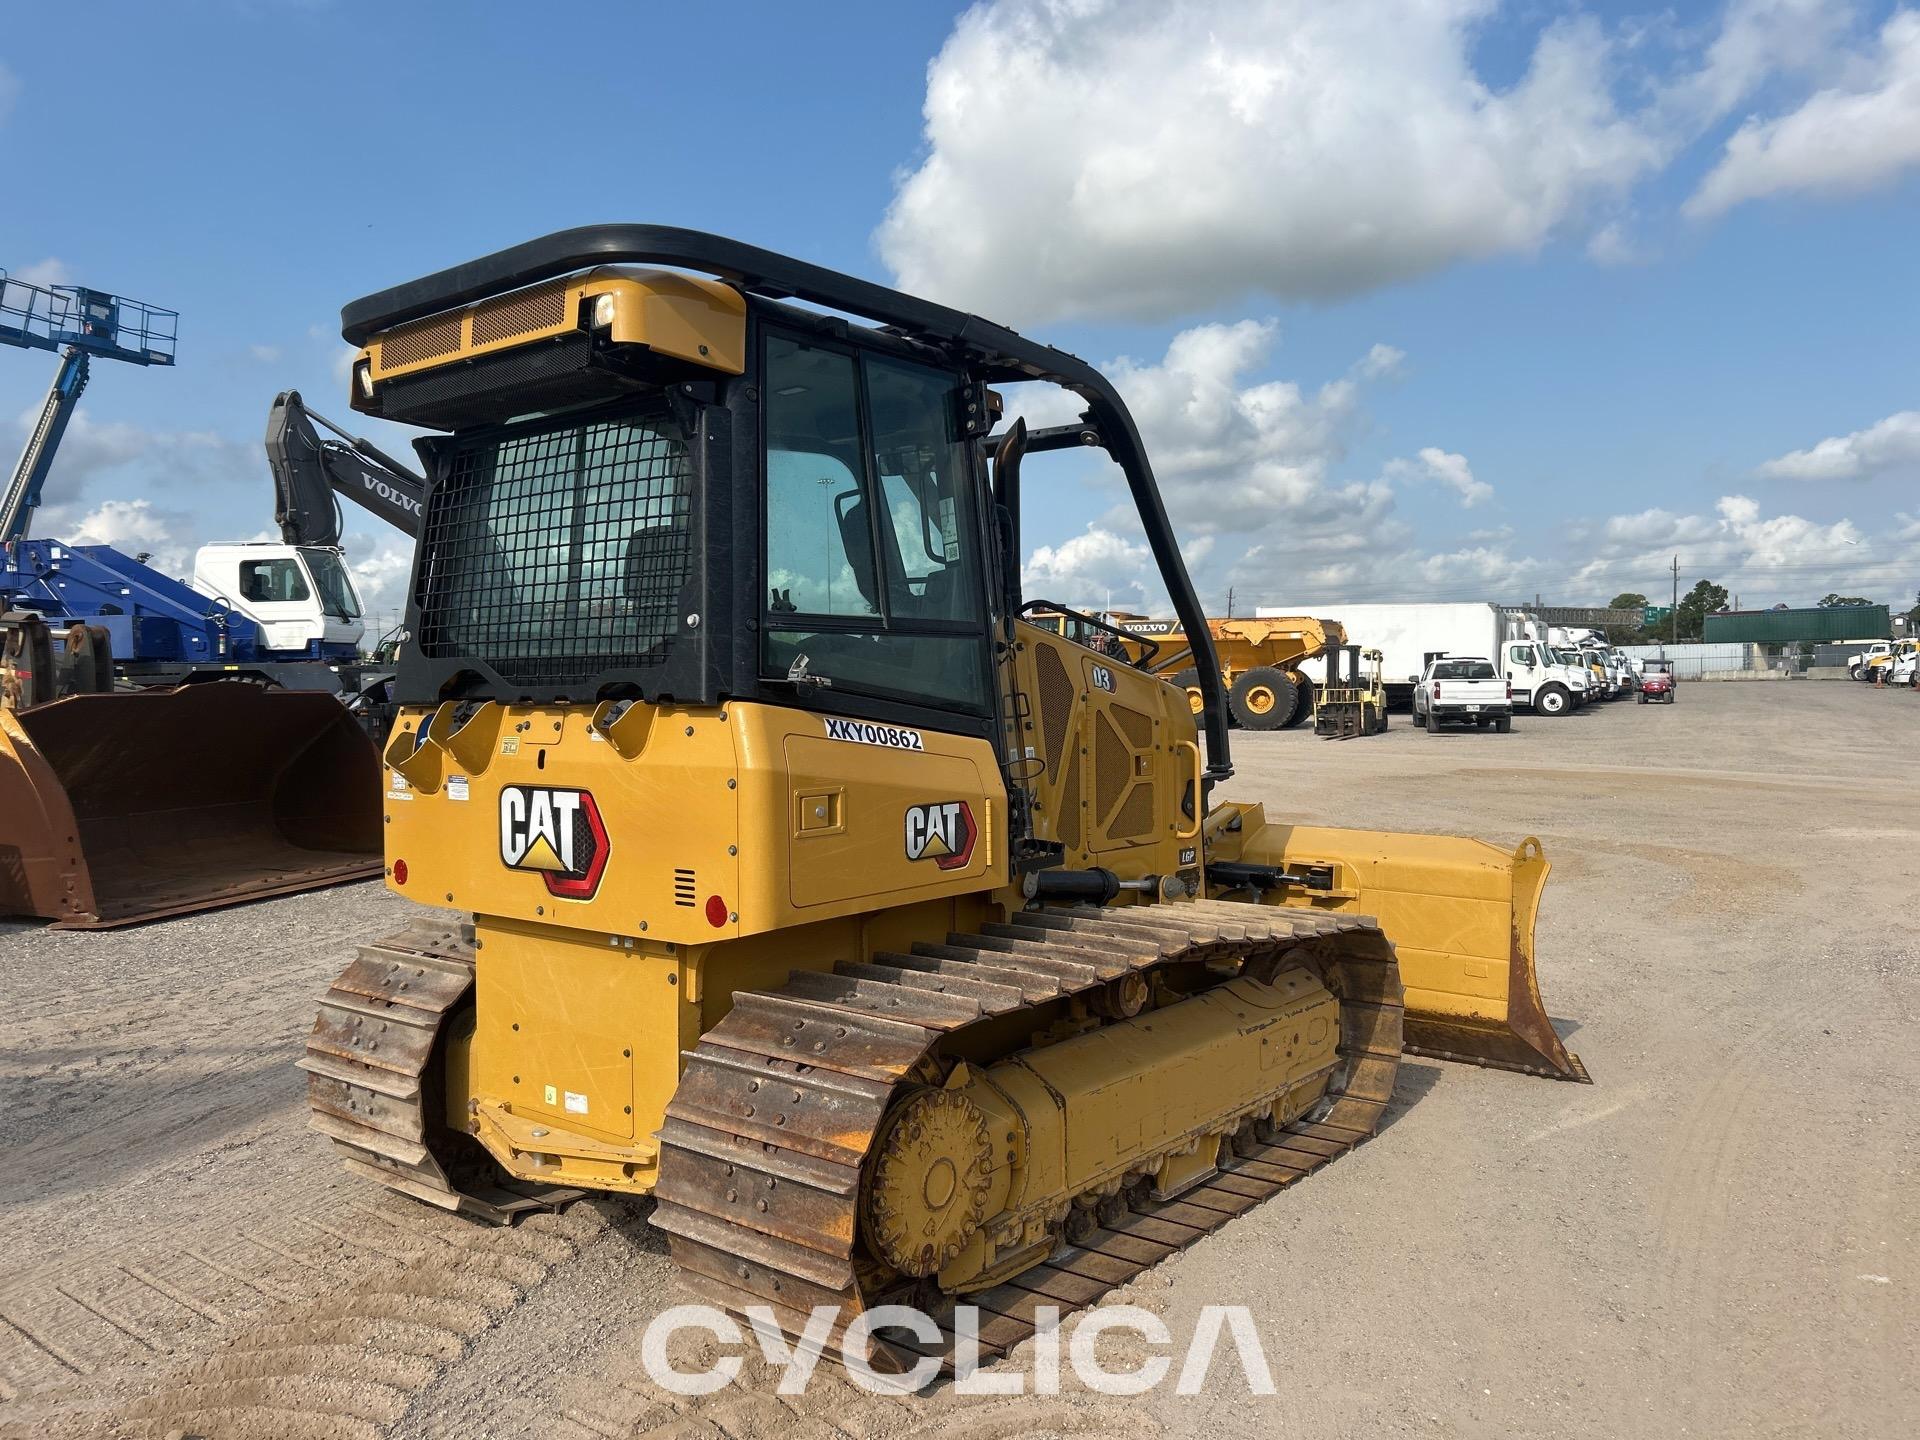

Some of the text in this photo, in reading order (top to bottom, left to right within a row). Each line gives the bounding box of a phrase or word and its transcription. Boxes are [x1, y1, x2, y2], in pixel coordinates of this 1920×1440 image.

[1124, 623, 1168, 632] VOLVO
[1093, 666, 1110, 690] D3
[825, 718, 922, 749] XKY00862
[500, 787, 580, 872] CAT
[906, 803, 960, 859] CAT
[1181, 850, 1195, 863] LGP
